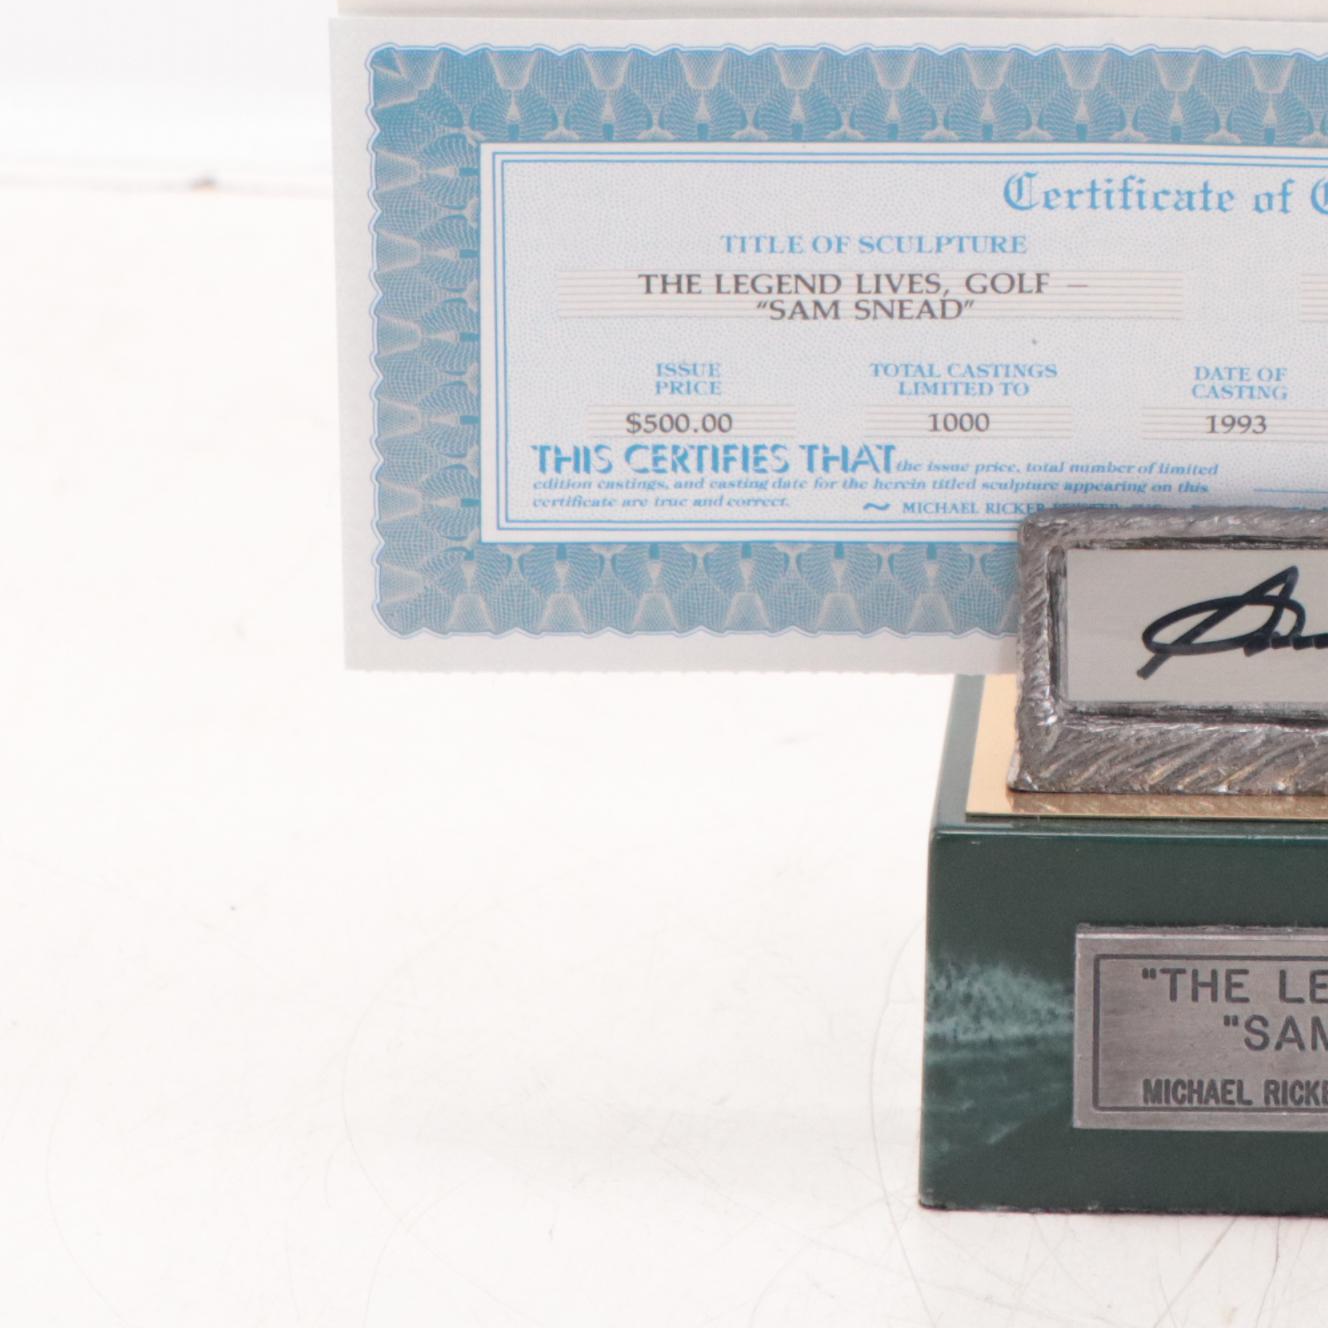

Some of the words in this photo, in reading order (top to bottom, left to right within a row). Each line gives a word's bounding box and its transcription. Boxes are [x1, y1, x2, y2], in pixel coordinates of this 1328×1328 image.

[1002, 172, 1235, 214] Certificate
[1253, 181, 1294, 215] of
[720, 236, 804, 253] TITLE
[812, 236, 850, 253] OF
[859, 236, 1028, 254] SCULPTURE
[639, 273, 701, 294] THE
[715, 274, 842, 294] LEGEND
[856, 274, 951, 298] LIVES,
[964, 274, 1050, 295] GOLF
[656, 363, 720, 378] ISSUE
[870, 364, 940, 378] TOTAL
[946, 364, 1058, 379] CASTINGS
[1194, 366, 1251, 382] DATE
[1258, 367, 1287, 383] OF
[656, 381, 721, 396] PRICE
[898, 382, 998, 397] LIMITED
[1002, 382, 1029, 397] TO
[1191, 384, 1287, 401] CASTING
[626, 411, 733, 435] $500.00
[928, 413, 990, 434] 1000
[1205, 414, 1267, 434] 1993
[530, 444, 613, 474] THIS
[624, 444, 790, 474] CERTIFIES
[799, 444, 896, 474] THAT
[897, 460, 922, 471] the
[928, 461, 969, 471] issue
[1027, 462, 1064, 472] total
[1070, 462, 1135, 473] number
[1138, 462, 1155, 474] of
[1159, 463, 1218, 475] limited
[533, 478, 592, 490] edition
[674, 479, 704, 490] and
[710, 480, 768, 492] casting
[772, 480, 806, 490] date
[813, 477, 838, 490] for
[843, 478, 867, 489] the
[873, 478, 926, 489] herein
[932, 479, 976, 490] titled
[982, 479, 1059, 492] sculpture
[1064, 481, 1148, 493] appearing
[1152, 484, 1172, 492] on
[1178, 482, 1209, 493] this
[533, 496, 616, 508] certificate
[622, 498, 648, 508] are
[654, 498, 687, 508] true
[692, 496, 723, 507] and
[726, 498, 790, 508] correct.
[903, 502, 979, 514] MICHAEL
[1141, 967, 1250, 1003] "THE
[1142, 1079, 1253, 1106] MICHAEL
